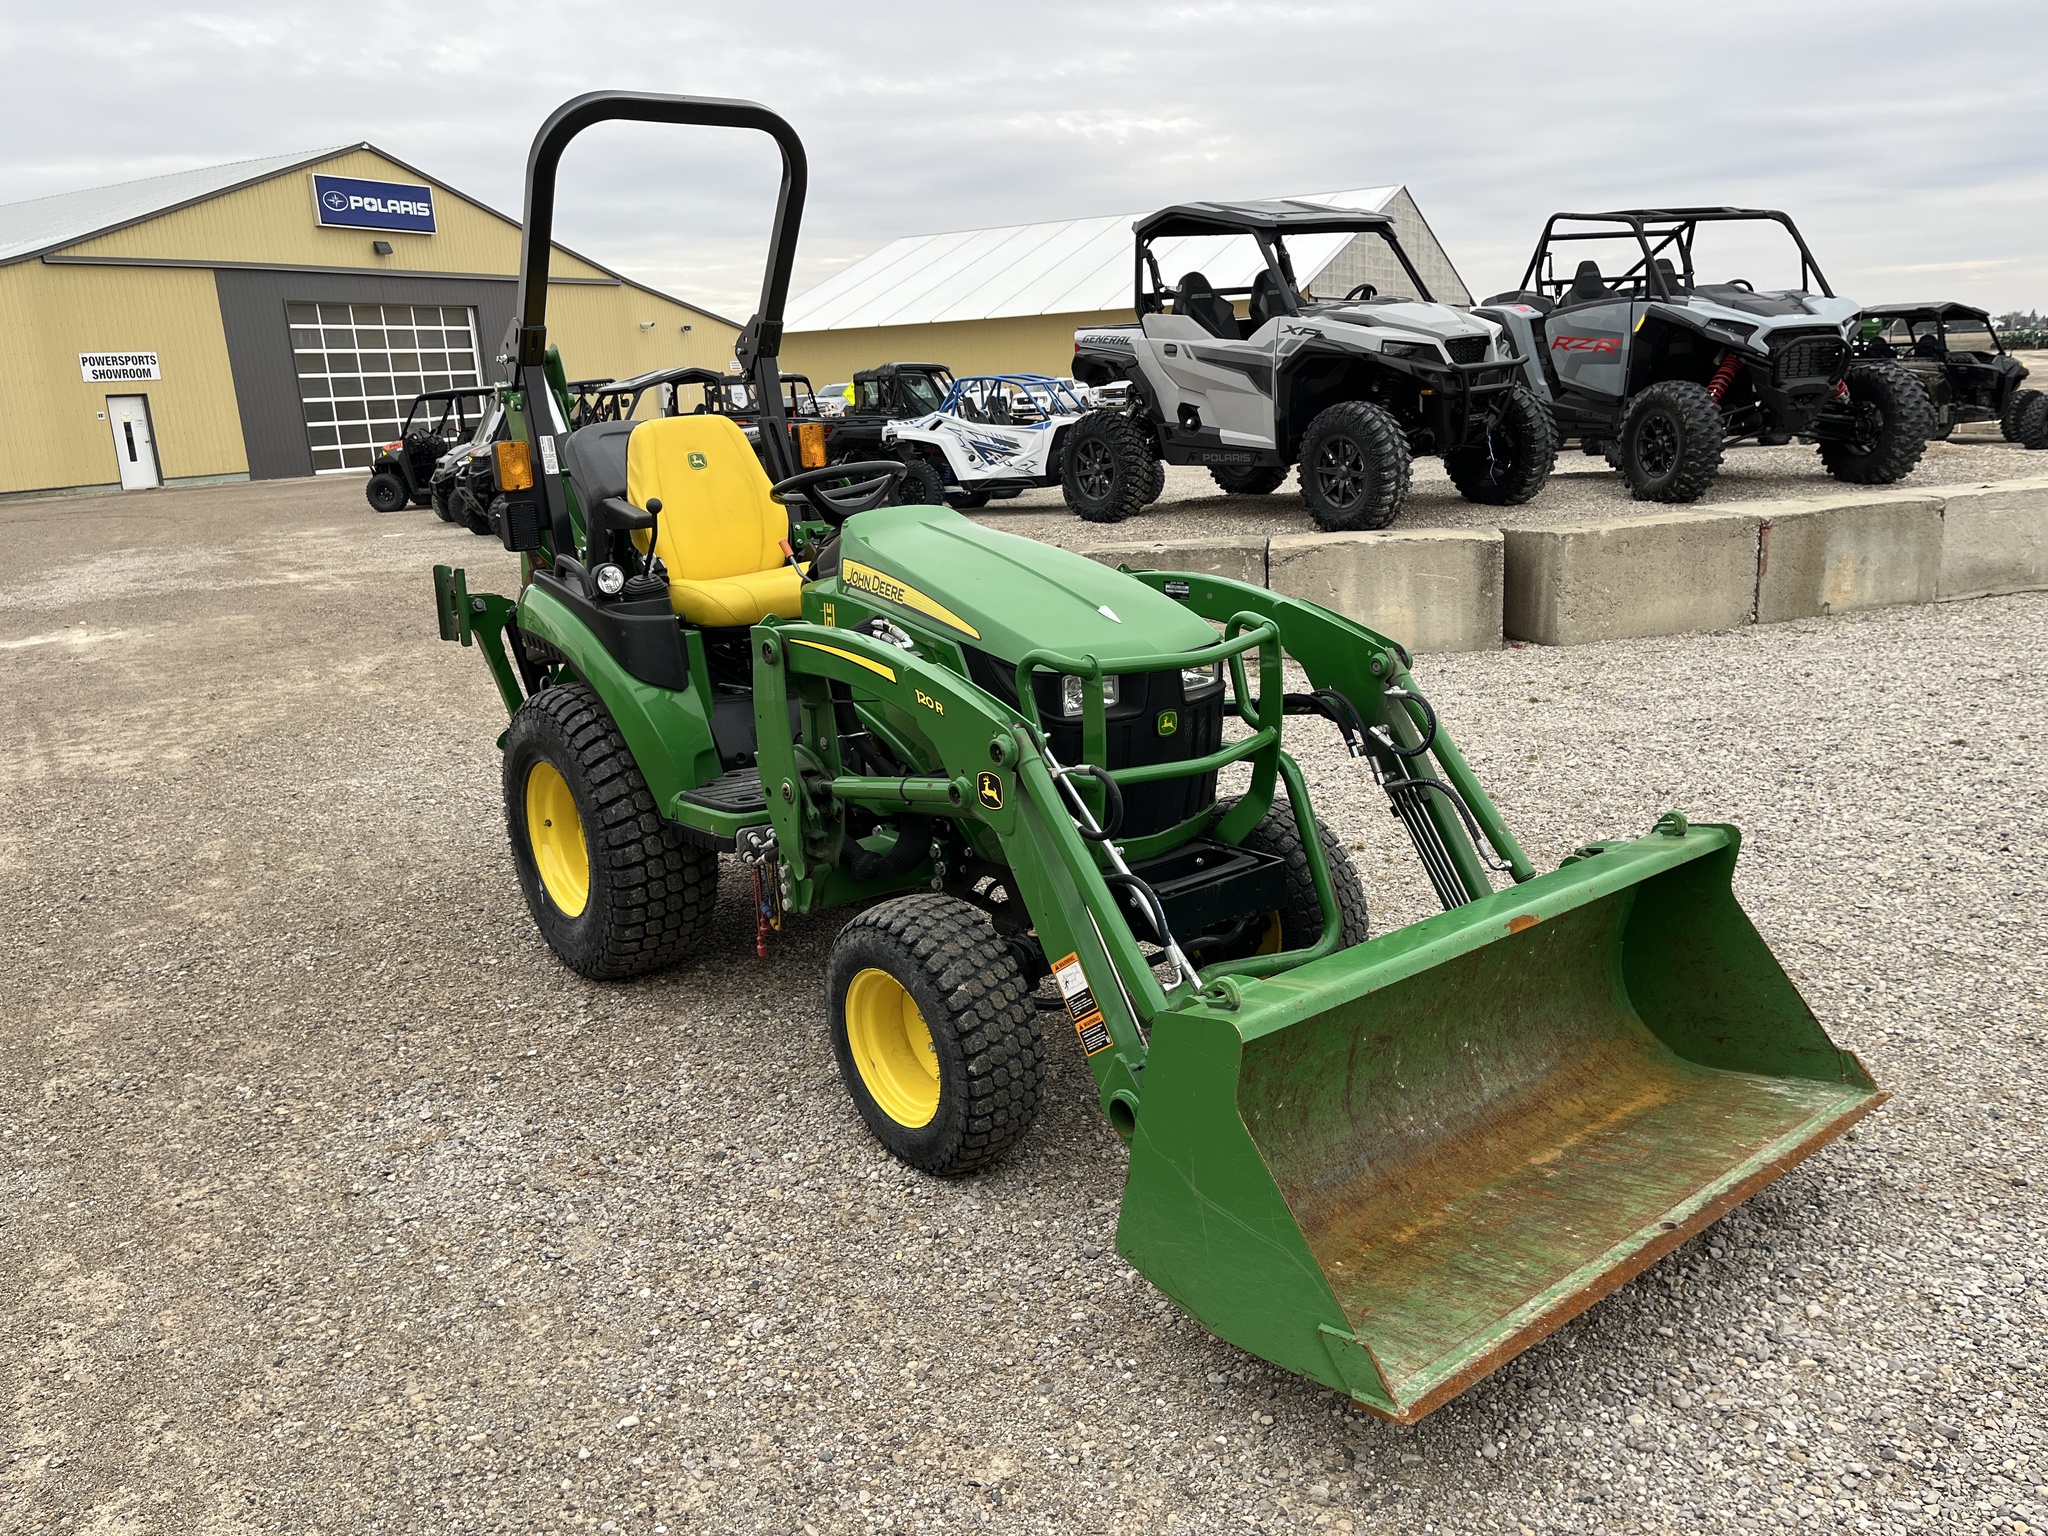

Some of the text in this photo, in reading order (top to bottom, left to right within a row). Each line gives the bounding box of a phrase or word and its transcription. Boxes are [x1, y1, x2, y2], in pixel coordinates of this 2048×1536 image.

[349, 195, 431, 217] POLARIS
[1081, 334, 1131, 346] GENERAL
[1551, 335, 1622, 354] RZR
[81, 355, 157, 367] POWERSPORTS
[91, 368, 152, 380] SHOWROOM
[1576, 409, 1612, 422] POLARIS
[1202, 453, 1251, 462] POLARIS
[846, 567, 905, 603] JOHN DEERE
